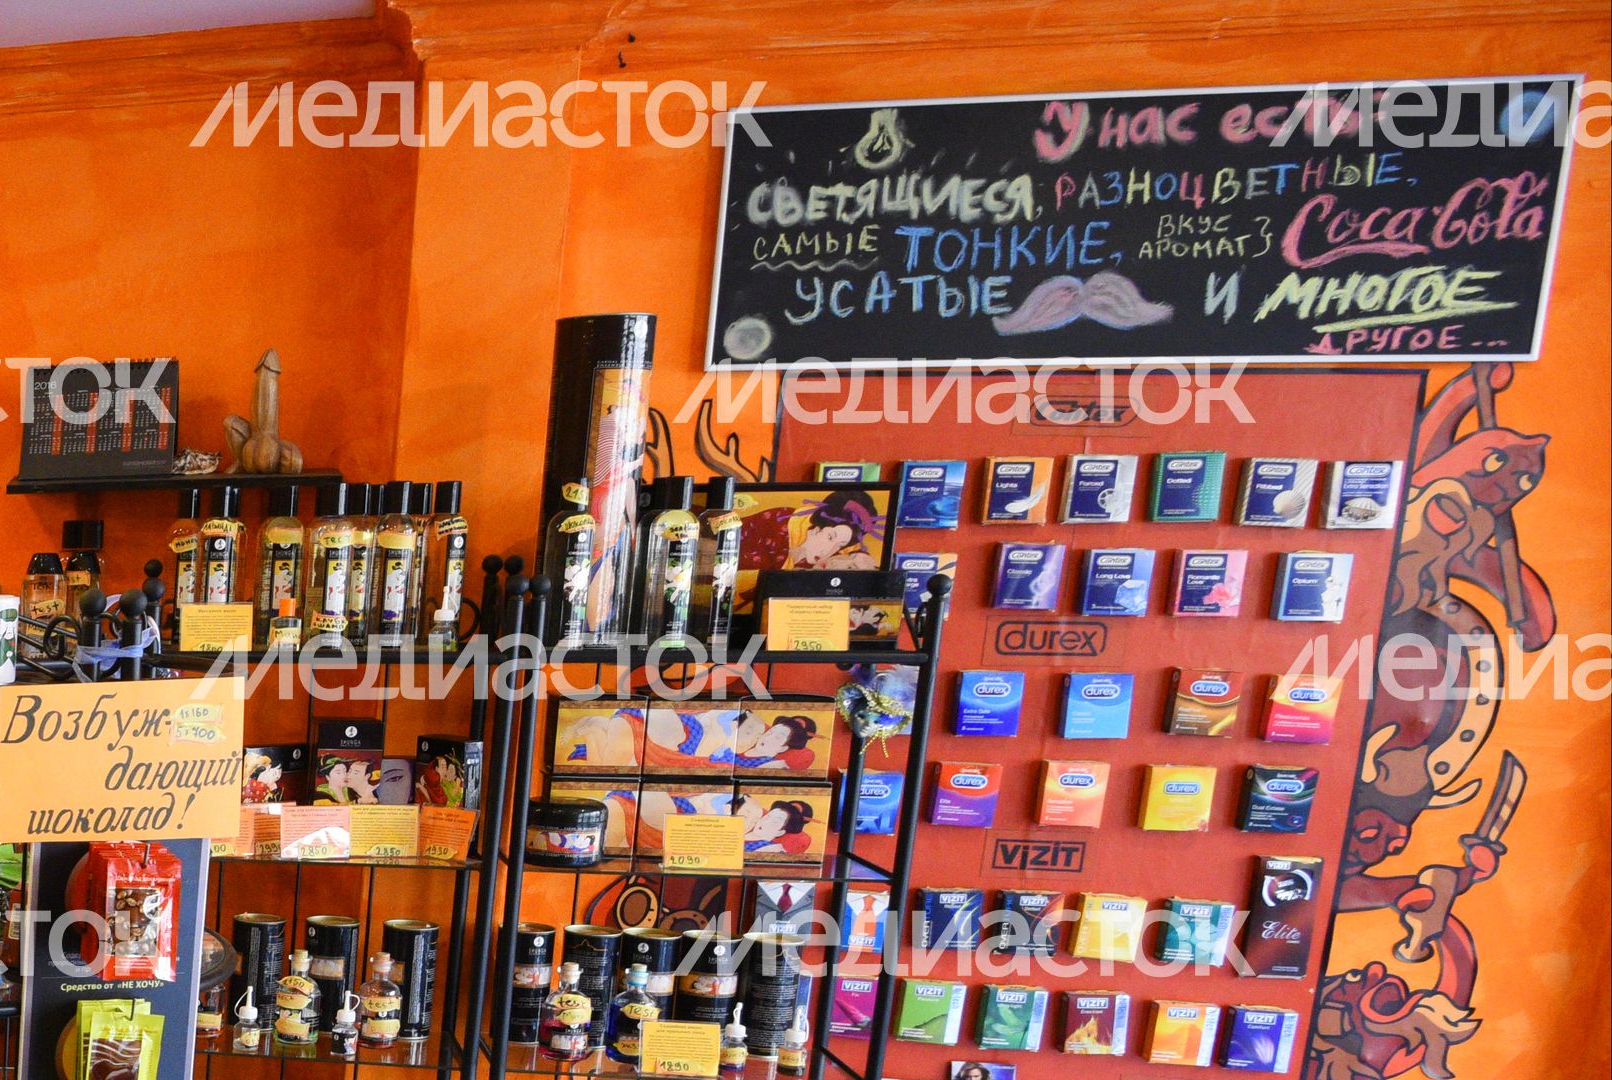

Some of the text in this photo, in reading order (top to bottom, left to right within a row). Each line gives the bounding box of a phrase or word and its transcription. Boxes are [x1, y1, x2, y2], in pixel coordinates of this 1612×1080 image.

[1033, 98, 1091, 164] У
[1097, 102, 1201, 149] нас
[1055, 152, 1419, 212] РАЗНОЦВЕТНЫЕ,
[1157, 214, 1232, 238] ВКУС
[753, 221, 1123, 273] САМЫЕ ТОНКИЕ,
[1139, 234, 1251, 260] АРОМАТ
[785, 265, 1503, 326] УСАТЫЕ И МНОГОЕ
[996, 481, 1018, 490] Lights
[1003, 621, 1099, 652] durex
[976, 684, 1008, 696] durex
[1084, 686, 1117, 697] durex
[1192, 681, 1228, 694] durex
[1290, 689, 1326, 701] durex
[0, 692, 172, 751] Возбуж-
[104, 745, 243, 794] дающий
[954, 775, 985, 787] durex
[1062, 775, 1092, 786] durex
[1166, 783, 1199, 793] durex
[1268, 780, 1302, 793] durex
[27, 792, 196, 836] шоколад!
[1261, 920, 1301, 941] Elite
[60, 983, 102, 993] Средство
[117, 981, 135, 991] «НЕ
[135, 980, 165, 990] ХОЧУ»
